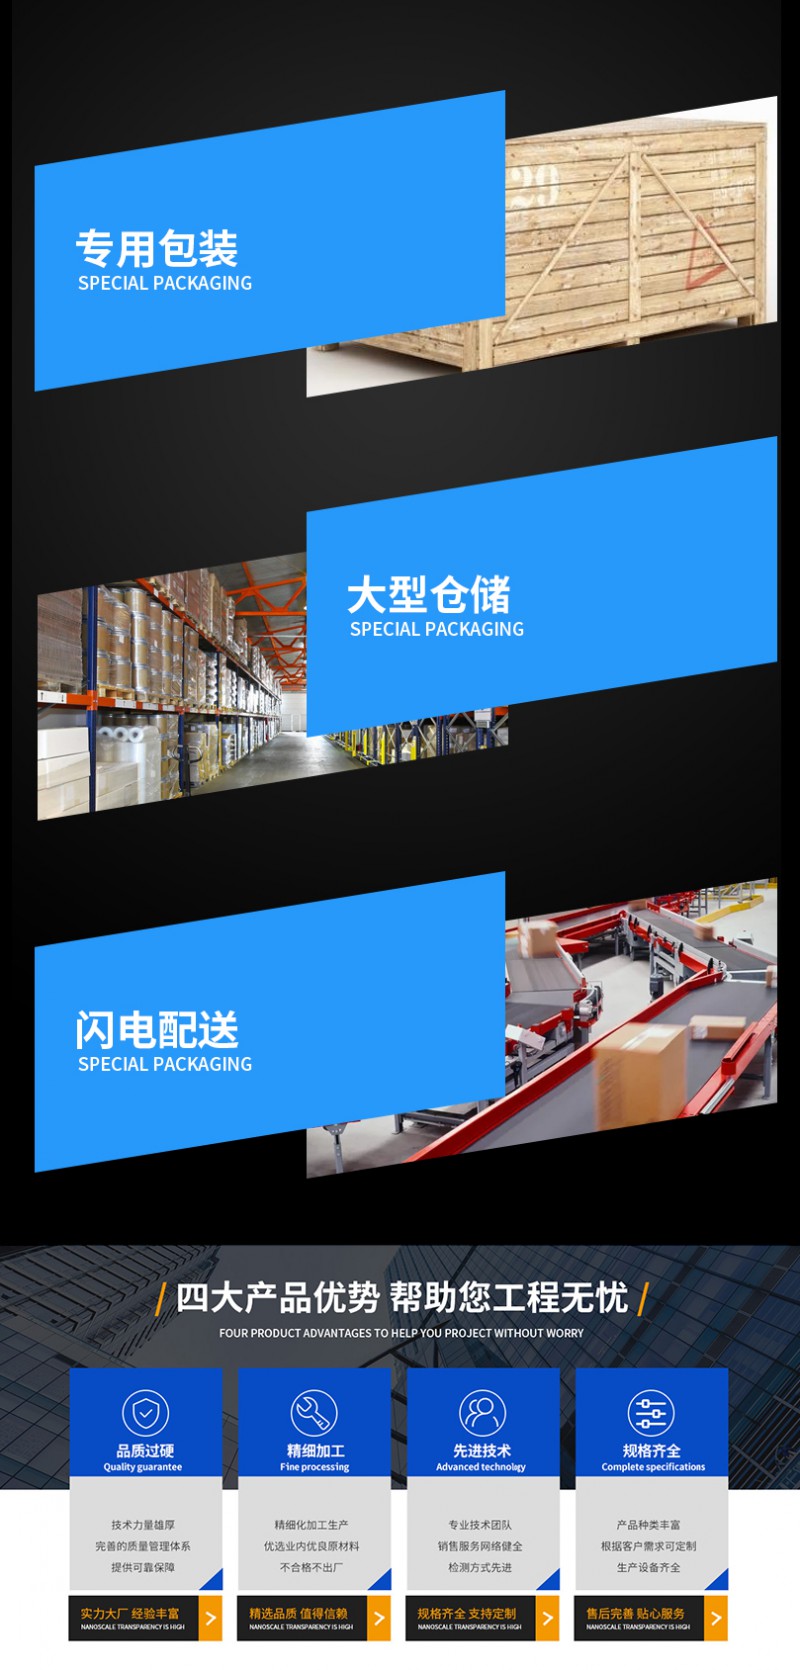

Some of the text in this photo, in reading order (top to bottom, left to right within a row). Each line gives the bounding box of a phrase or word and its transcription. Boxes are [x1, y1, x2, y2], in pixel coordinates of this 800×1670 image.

[76, 228, 237, 268] 专用包装
[79, 276, 252, 290] SPECIAL PACKAGING
[348, 575, 510, 614] 大型仓储
[351, 622, 523, 636] SPECIAL PACKAGING
[77, 1010, 238, 1049] 闪电配送
[79, 1057, 252, 1071] SPECIAL PACKAGING
[178, 1281, 628, 1313] 四大产品优势 帮助您工程无忧
[219, 1328, 584, 1338] FOUR PRODUCT ADVANTAGES TO HELP YOU PROJECT WITHOUT WORRY
[117, 1444, 174, 1458] 品质过硬
[287, 1443, 345, 1458] 精细加工
[454, 1443, 511, 1458] 先进技术
[623, 1443, 681, 1458] 规格齐全
[104, 1462, 183, 1473] Quality guarantee
[280, 1462, 349, 1473] Fine processing
[436, 1462, 526, 1473] Advanced technology
[602, 1462, 705, 1472] Complete specifications
[112, 1520, 174, 1530] 技术力量雄厚
[275, 1520, 348, 1530] 精细化加工生产
[449, 1520, 512, 1530] 专业技术团队
[617, 1520, 680, 1530] 产品种类丰富
[96, 1541, 190, 1551] 完善的质量管理体系
[264, 1541, 359, 1551] 优选业内优良原材料
[438, 1541, 522, 1551] 销售服务网络健全
[601, 1541, 696, 1551] 根据客户需求可定制
[112, 1563, 174, 1573] 提供可靠保障
[280, 1563, 343, 1572] 不合格不出厂
[449, 1562, 511, 1572] 检测方式先进
[617, 1562, 680, 1572] 生产设备齐全
[81, 1608, 179, 1619] 实力大厂 经验丰富
[250, 1608, 347, 1619] 精选品质 值得信赖
[418, 1608, 516, 1619] 规格齐全 支持定制
[587, 1608, 684, 1619] 售后完善 贴心服务
